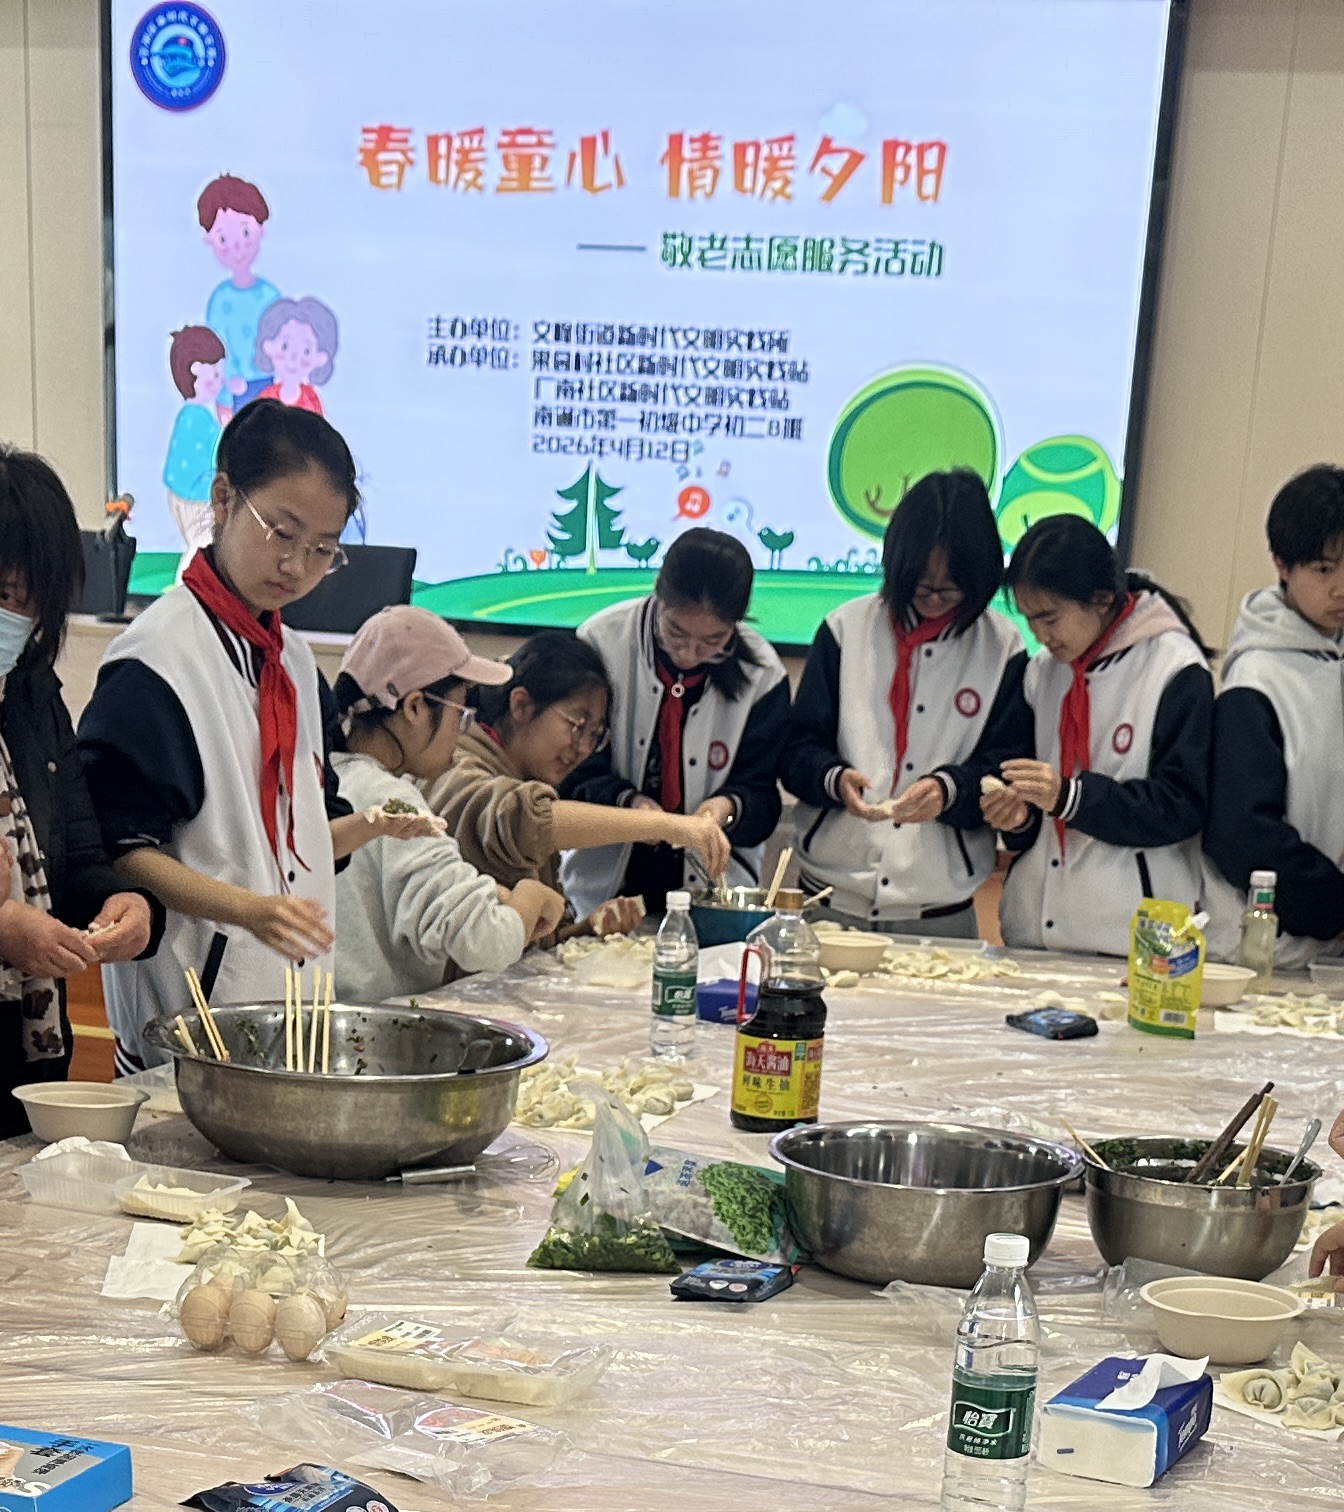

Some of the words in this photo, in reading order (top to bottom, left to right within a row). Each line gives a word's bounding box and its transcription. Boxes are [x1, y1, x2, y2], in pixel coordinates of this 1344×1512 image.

[358, 124, 626, 194] 春暖童心
[660, 132, 948, 204] 情暖夕阳
[661, 231, 944, 277] 敬老志愿服务活动
[532, 434, 691, 464] 2026年4月12日
